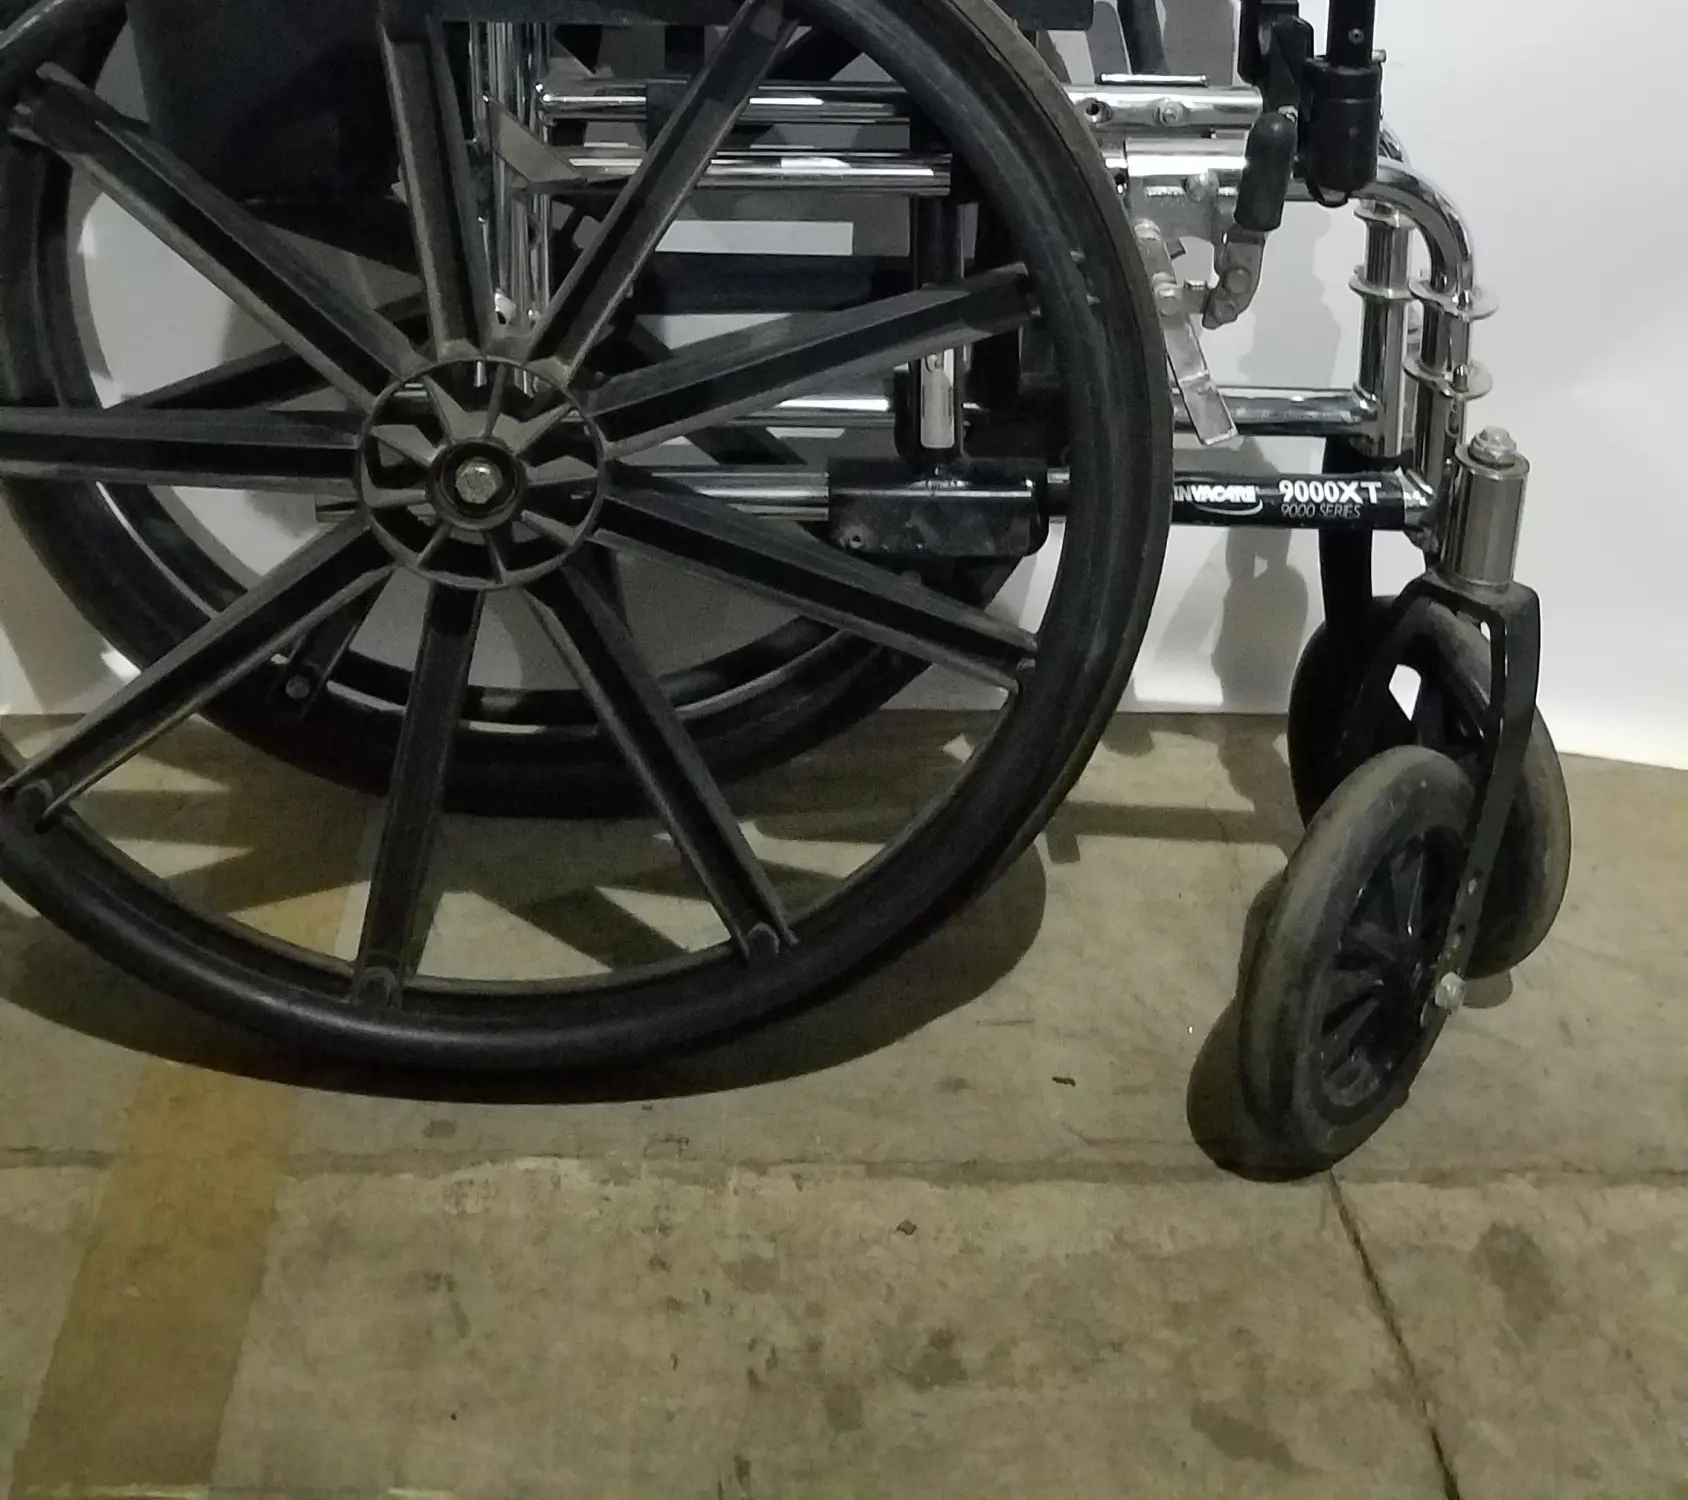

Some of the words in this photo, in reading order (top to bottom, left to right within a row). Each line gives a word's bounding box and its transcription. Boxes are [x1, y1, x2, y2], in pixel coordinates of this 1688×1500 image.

[1279, 480, 1382, 504] 9000XT
[1281, 503, 1315, 517] 9000
[1319, 502, 1362, 519] SERIES
